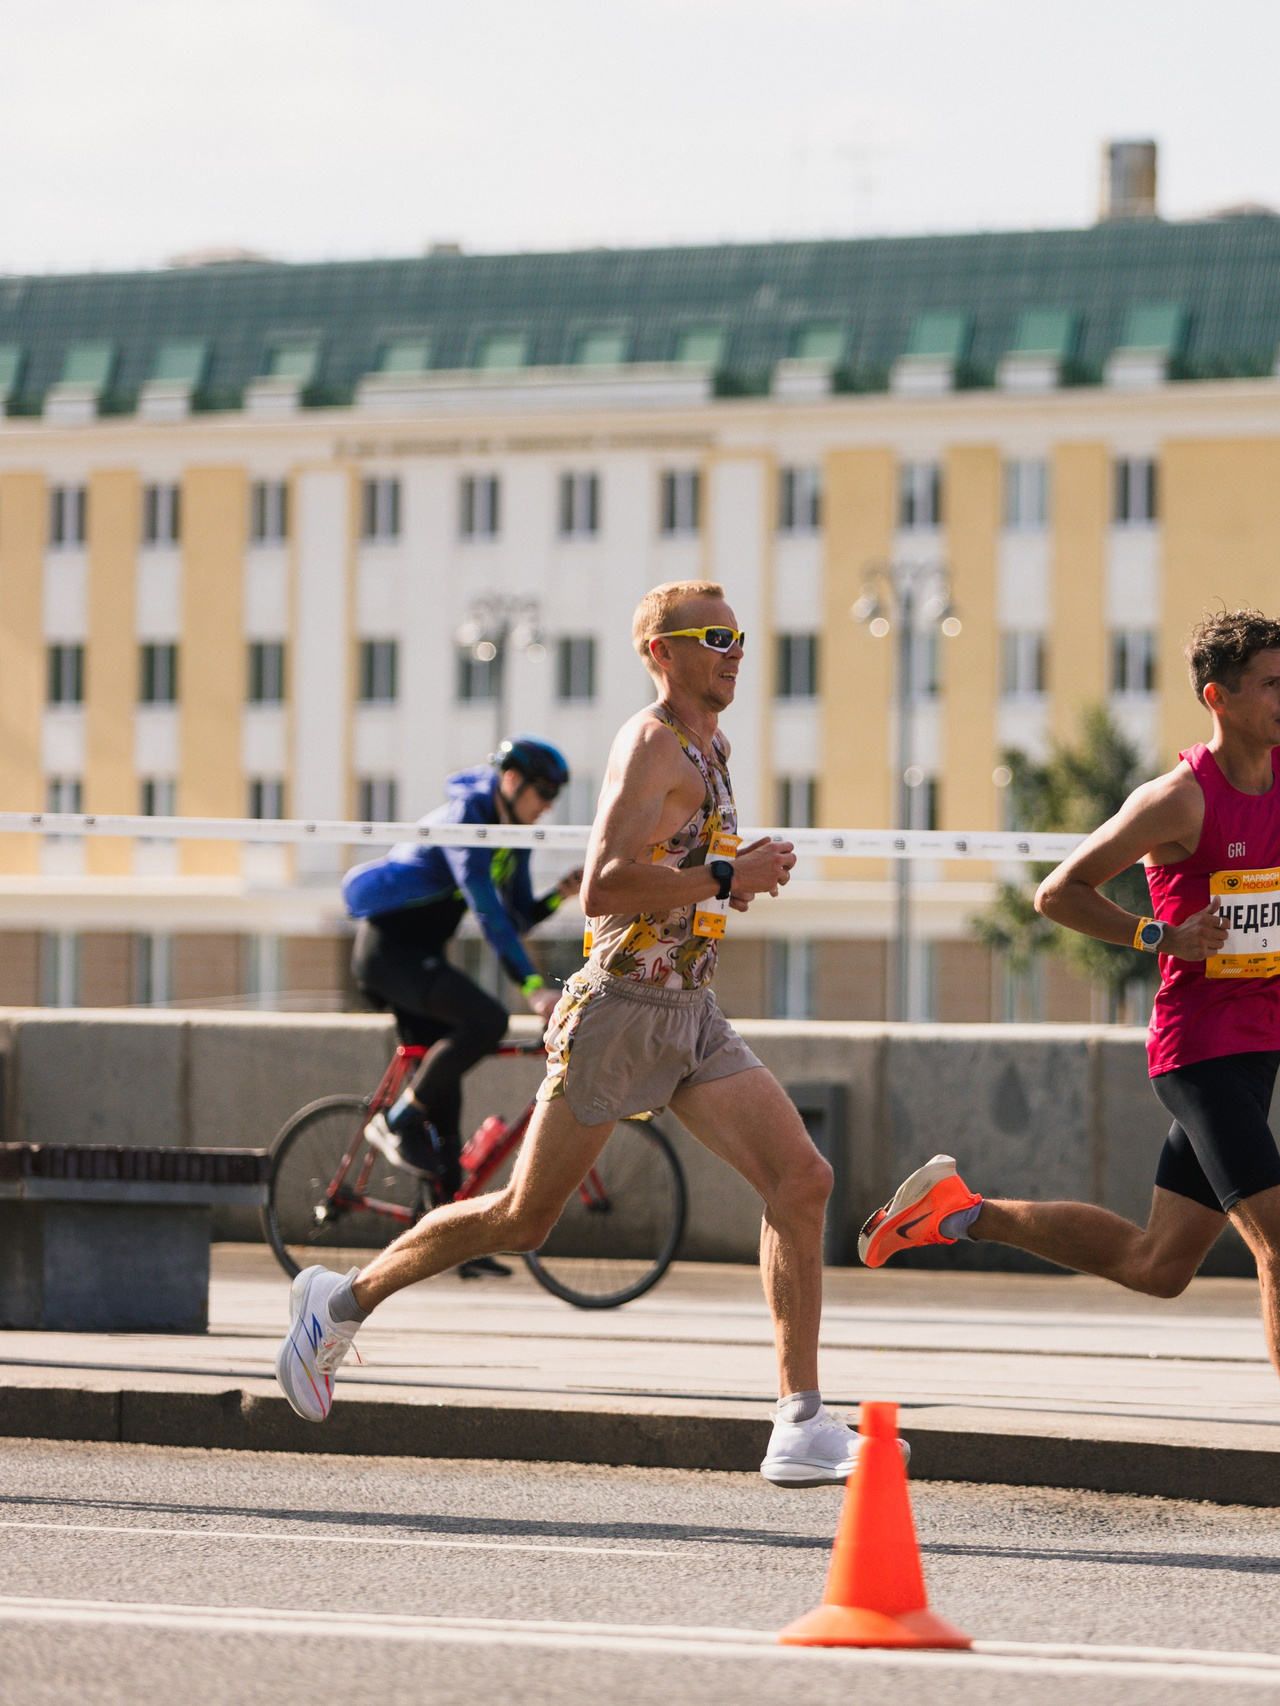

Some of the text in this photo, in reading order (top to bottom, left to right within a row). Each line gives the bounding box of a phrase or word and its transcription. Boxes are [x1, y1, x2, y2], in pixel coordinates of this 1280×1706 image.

[1242, 872, 1279, 882] МАРАФОН
[1242, 881, 1274, 889] МОСКВА
[1262, 938, 1267, 947] 3
